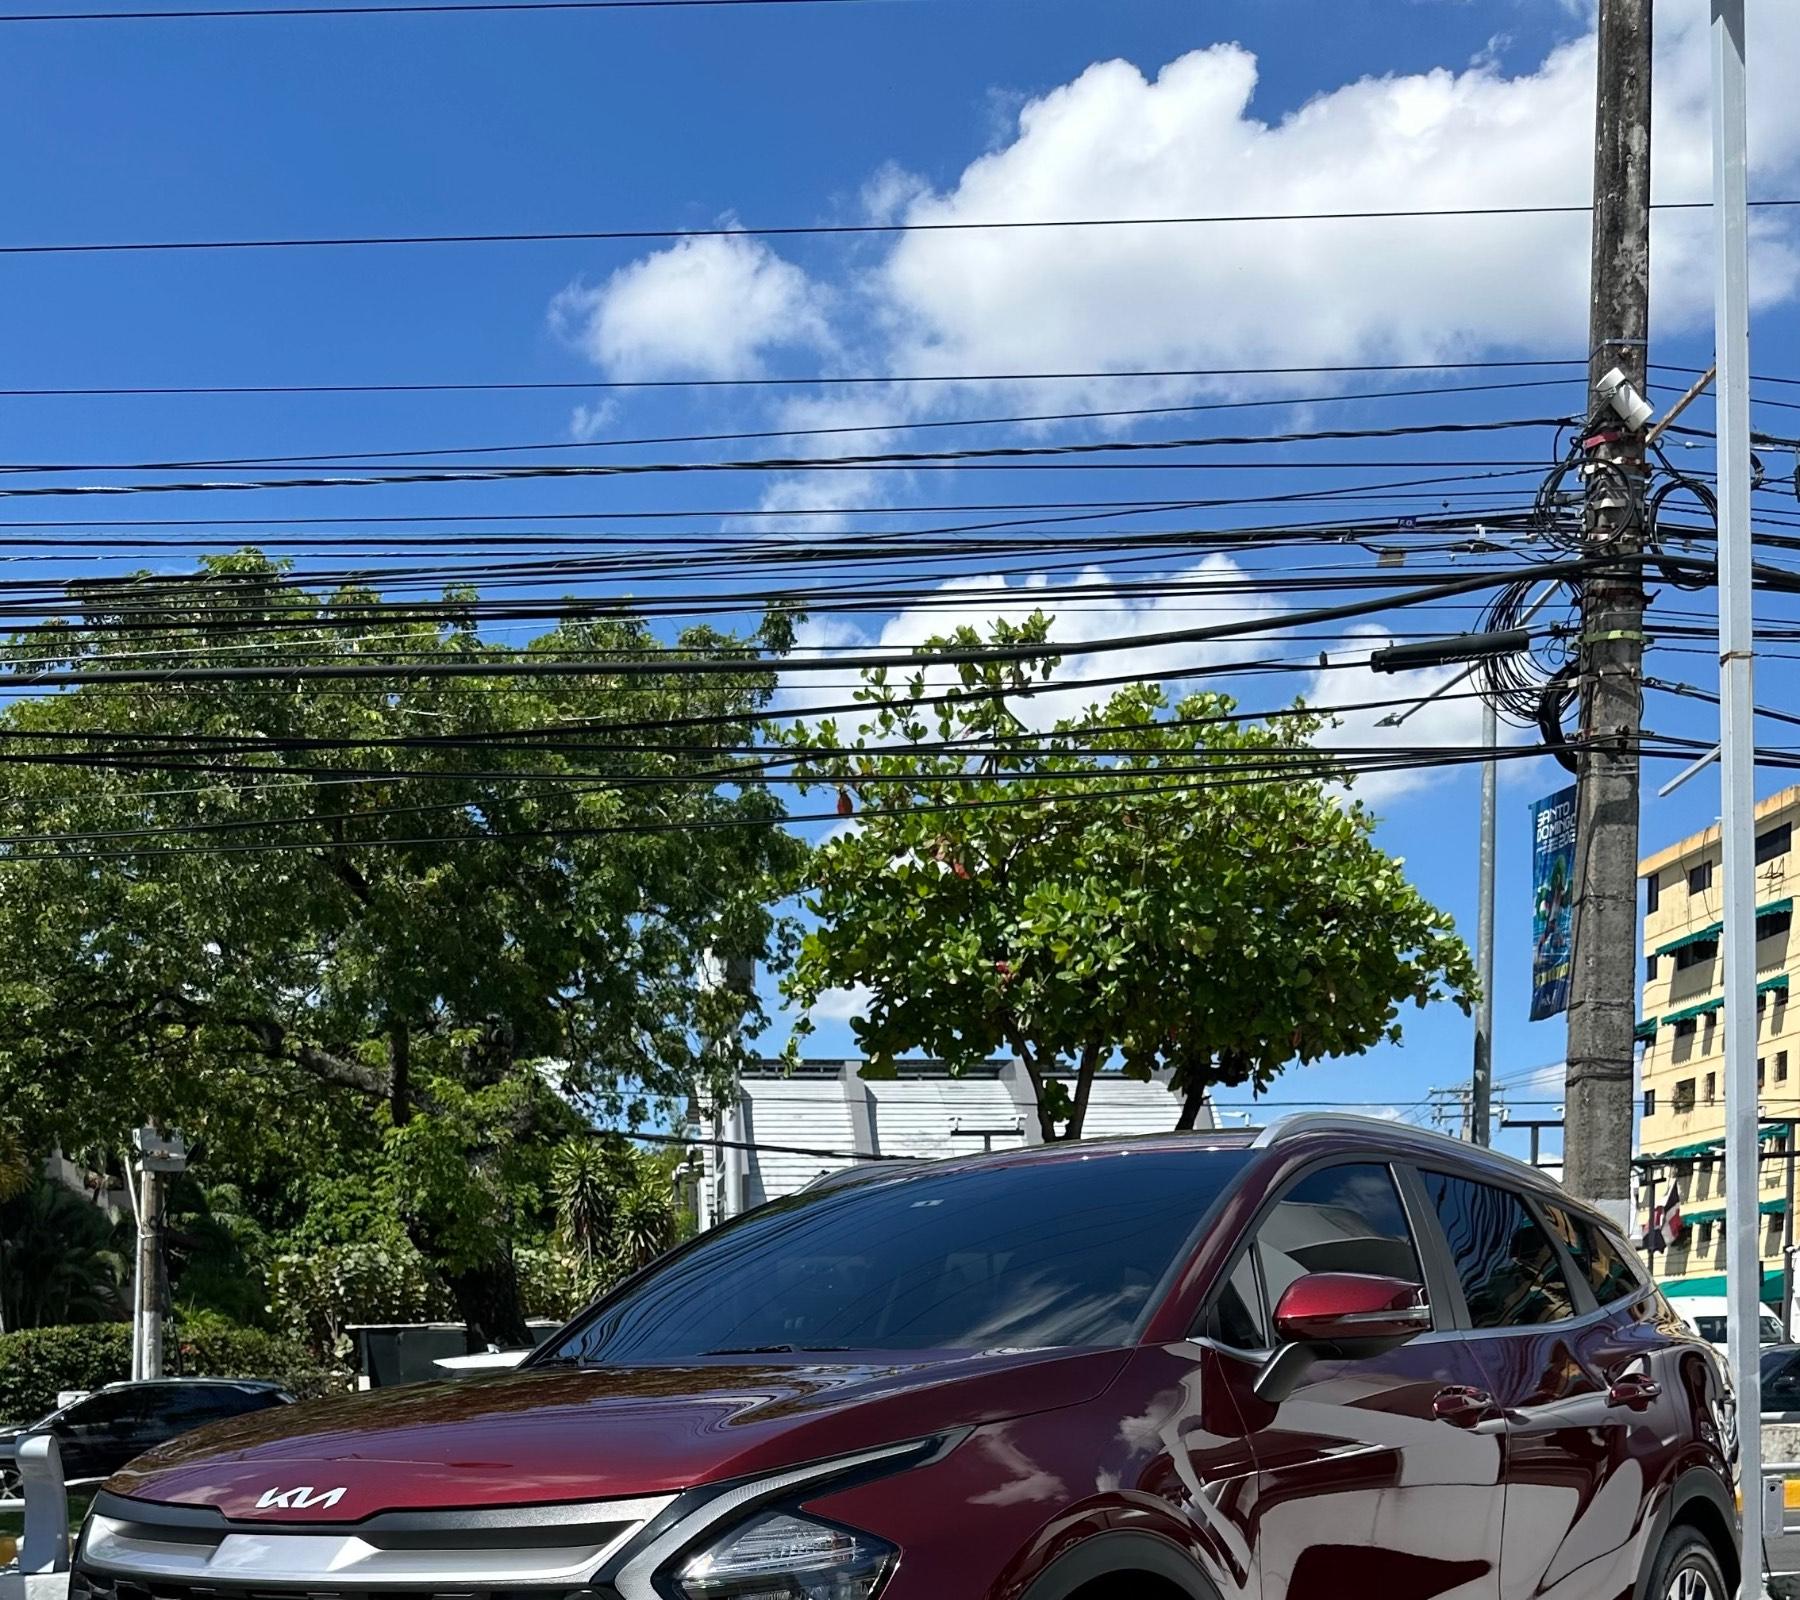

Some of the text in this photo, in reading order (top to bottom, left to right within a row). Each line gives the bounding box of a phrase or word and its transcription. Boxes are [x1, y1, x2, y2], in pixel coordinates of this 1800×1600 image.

[1536, 812, 1576, 843] DOMINGO
[1537, 801, 1570, 828] SANTO
[255, 1487, 348, 1510] KIA
